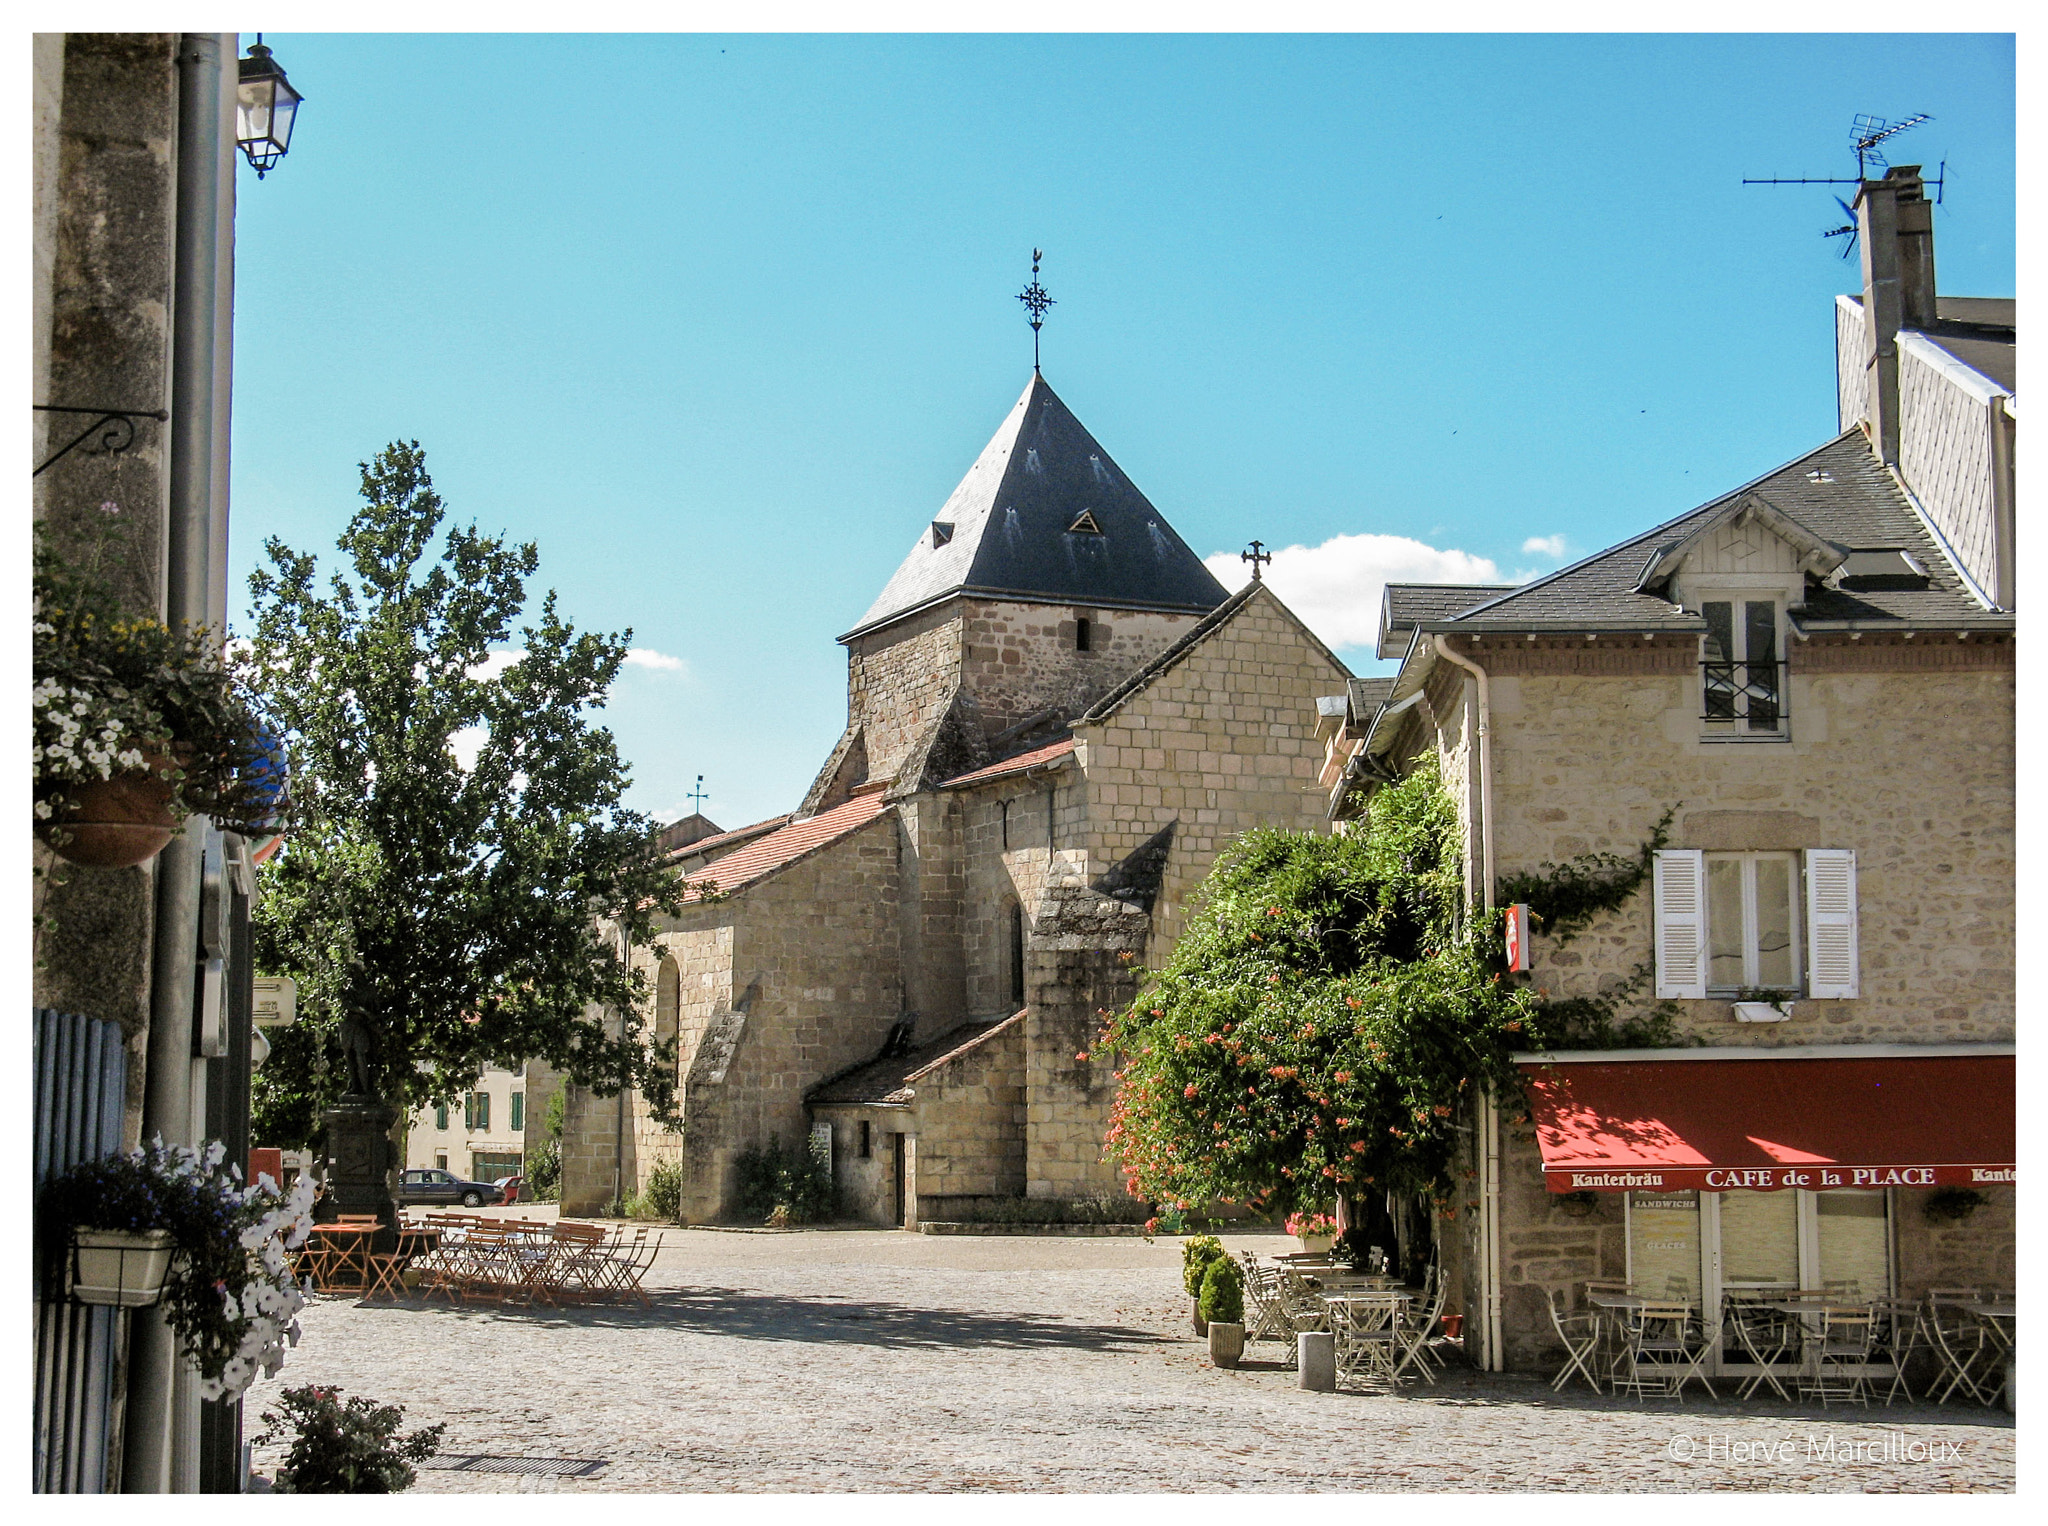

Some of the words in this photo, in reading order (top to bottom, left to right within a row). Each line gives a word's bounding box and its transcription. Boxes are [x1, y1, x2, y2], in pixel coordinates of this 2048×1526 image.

[1572, 1173, 1663, 1187] Kanterbräu
[1705, 1170, 1773, 1187] CAFE
[1782, 1169, 1809, 1186] de
[1820, 1169, 1841, 1185] la
[1852, 1168, 1935, 1185] PLACE
[1634, 1200, 1696, 1208] SANDWICHS
